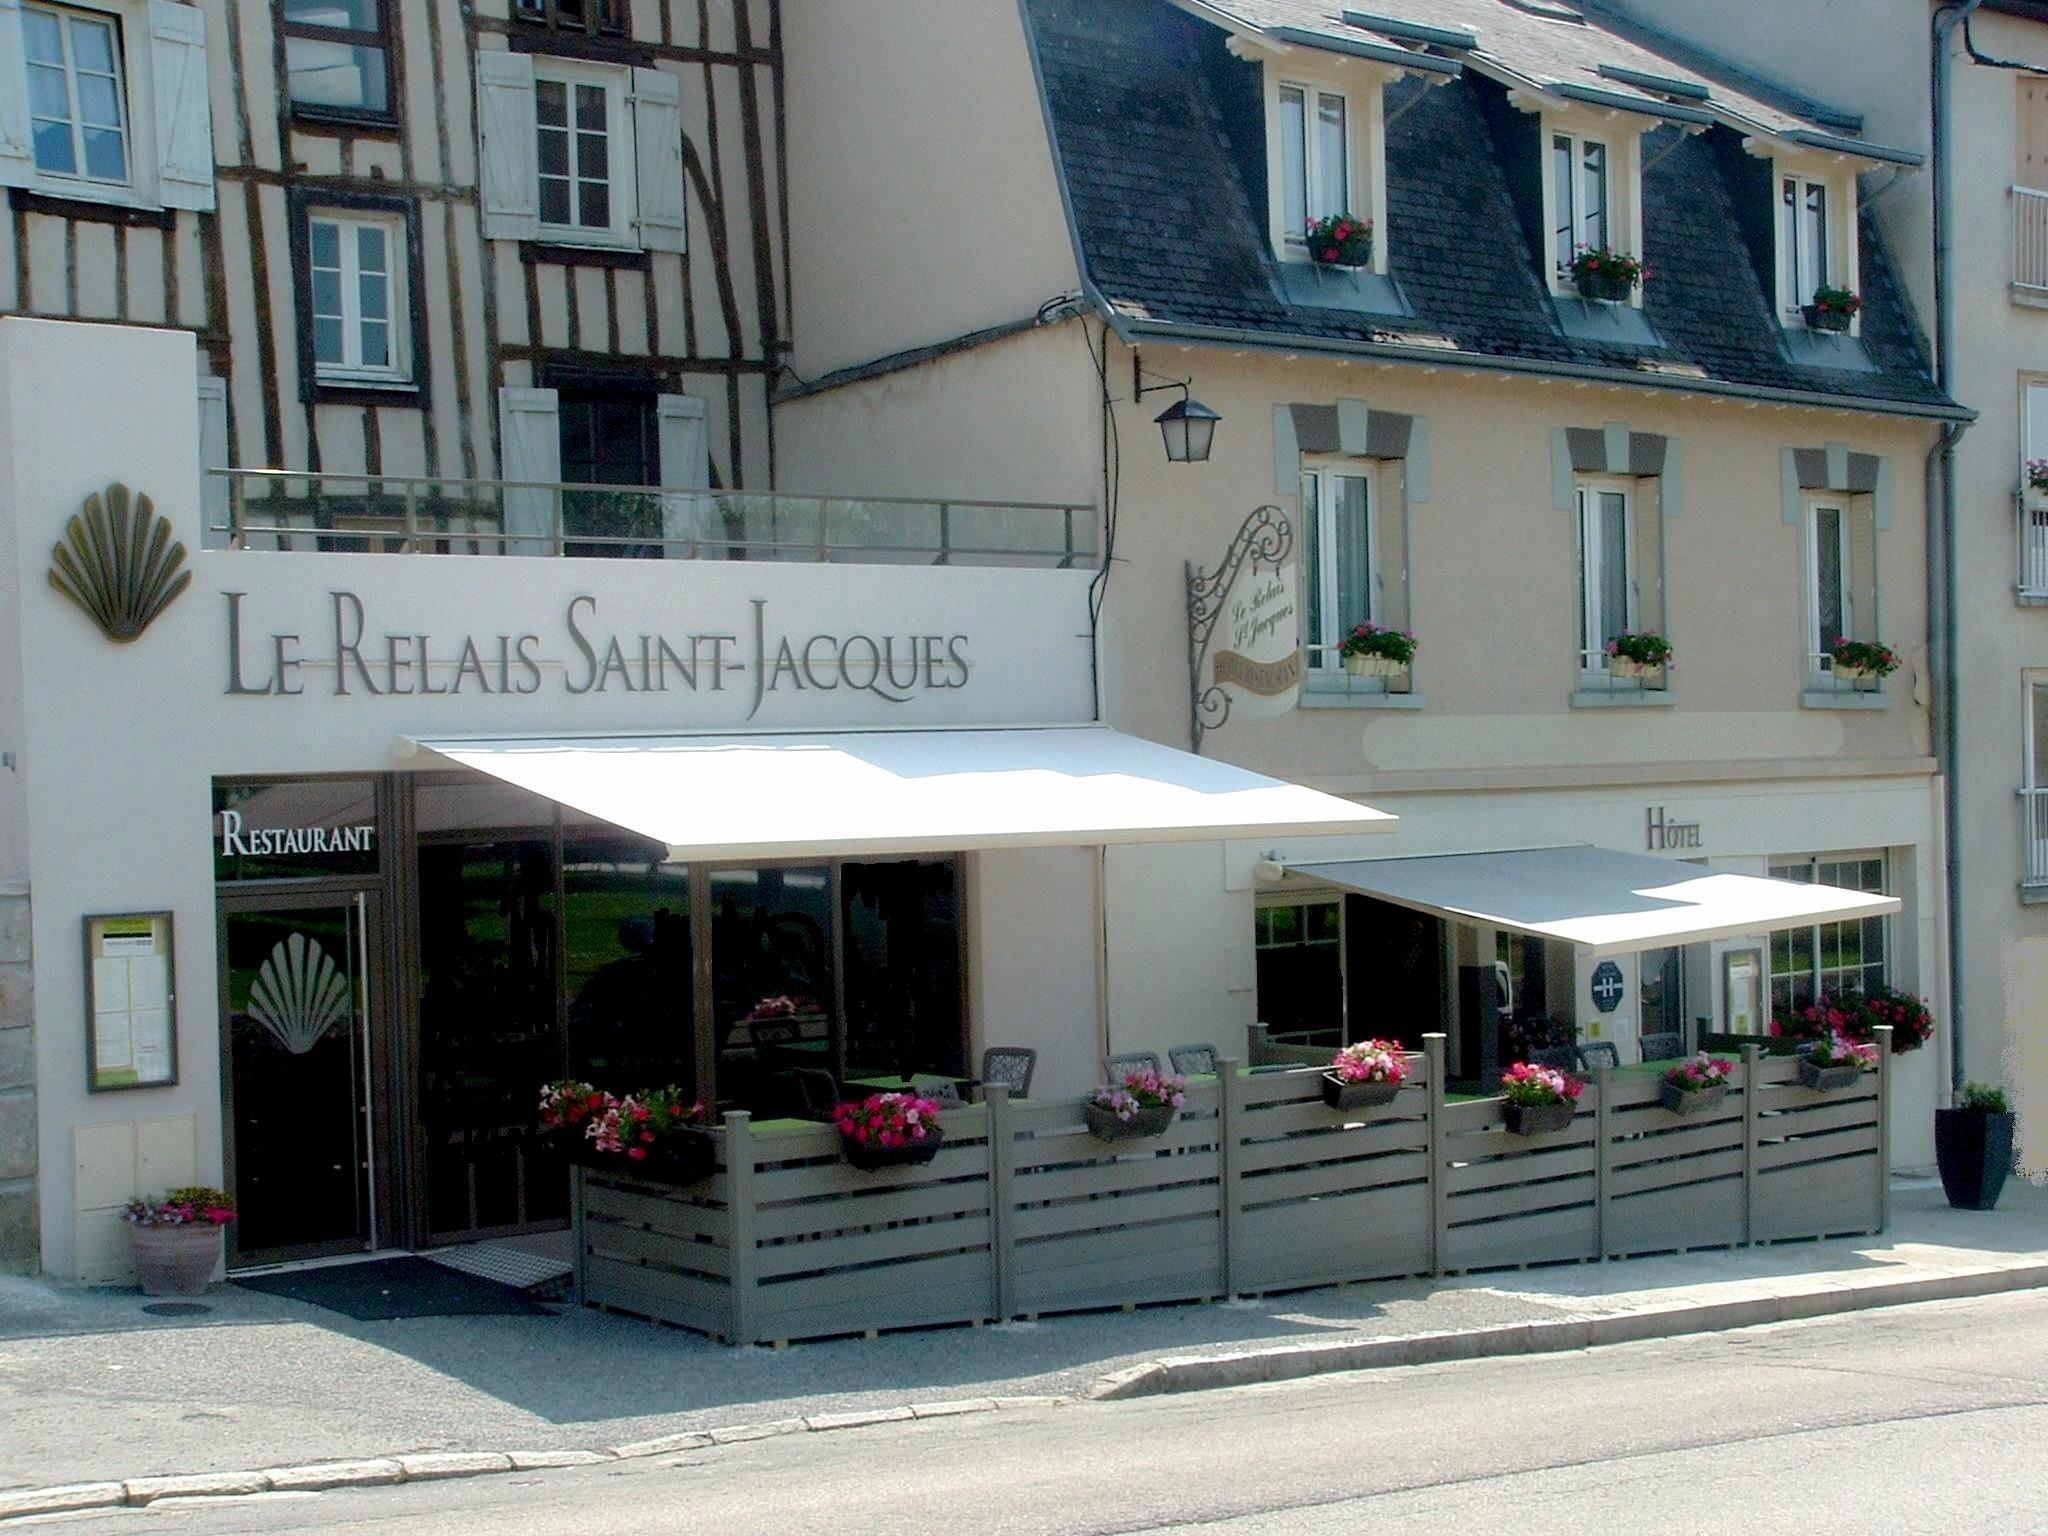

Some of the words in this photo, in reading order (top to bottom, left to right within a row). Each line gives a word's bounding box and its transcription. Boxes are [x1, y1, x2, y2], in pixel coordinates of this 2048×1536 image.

[220, 591, 303, 696] LE
[327, 591, 542, 696] RELAIS
[563, 595, 971, 722] SAINT-JACQUES
[220, 809, 374, 857] RESTAURANT
[1645, 806, 1703, 850] HÔTEL
